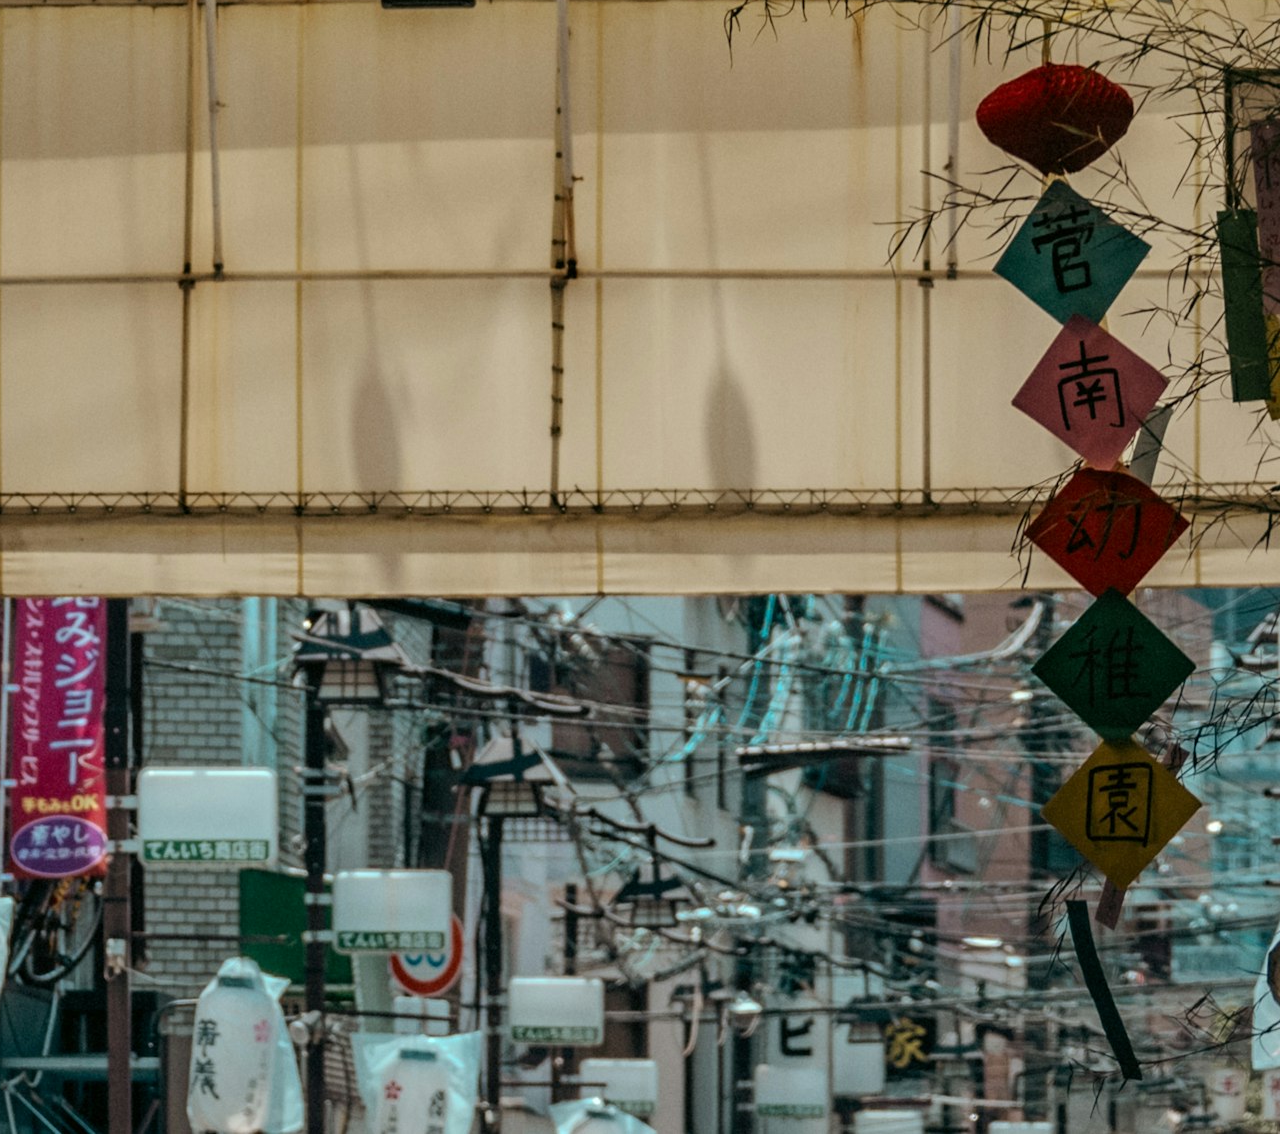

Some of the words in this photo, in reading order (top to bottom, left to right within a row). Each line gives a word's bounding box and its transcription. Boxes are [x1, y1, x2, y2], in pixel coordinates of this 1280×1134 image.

[146, 841, 268, 861] てんいち商店街
